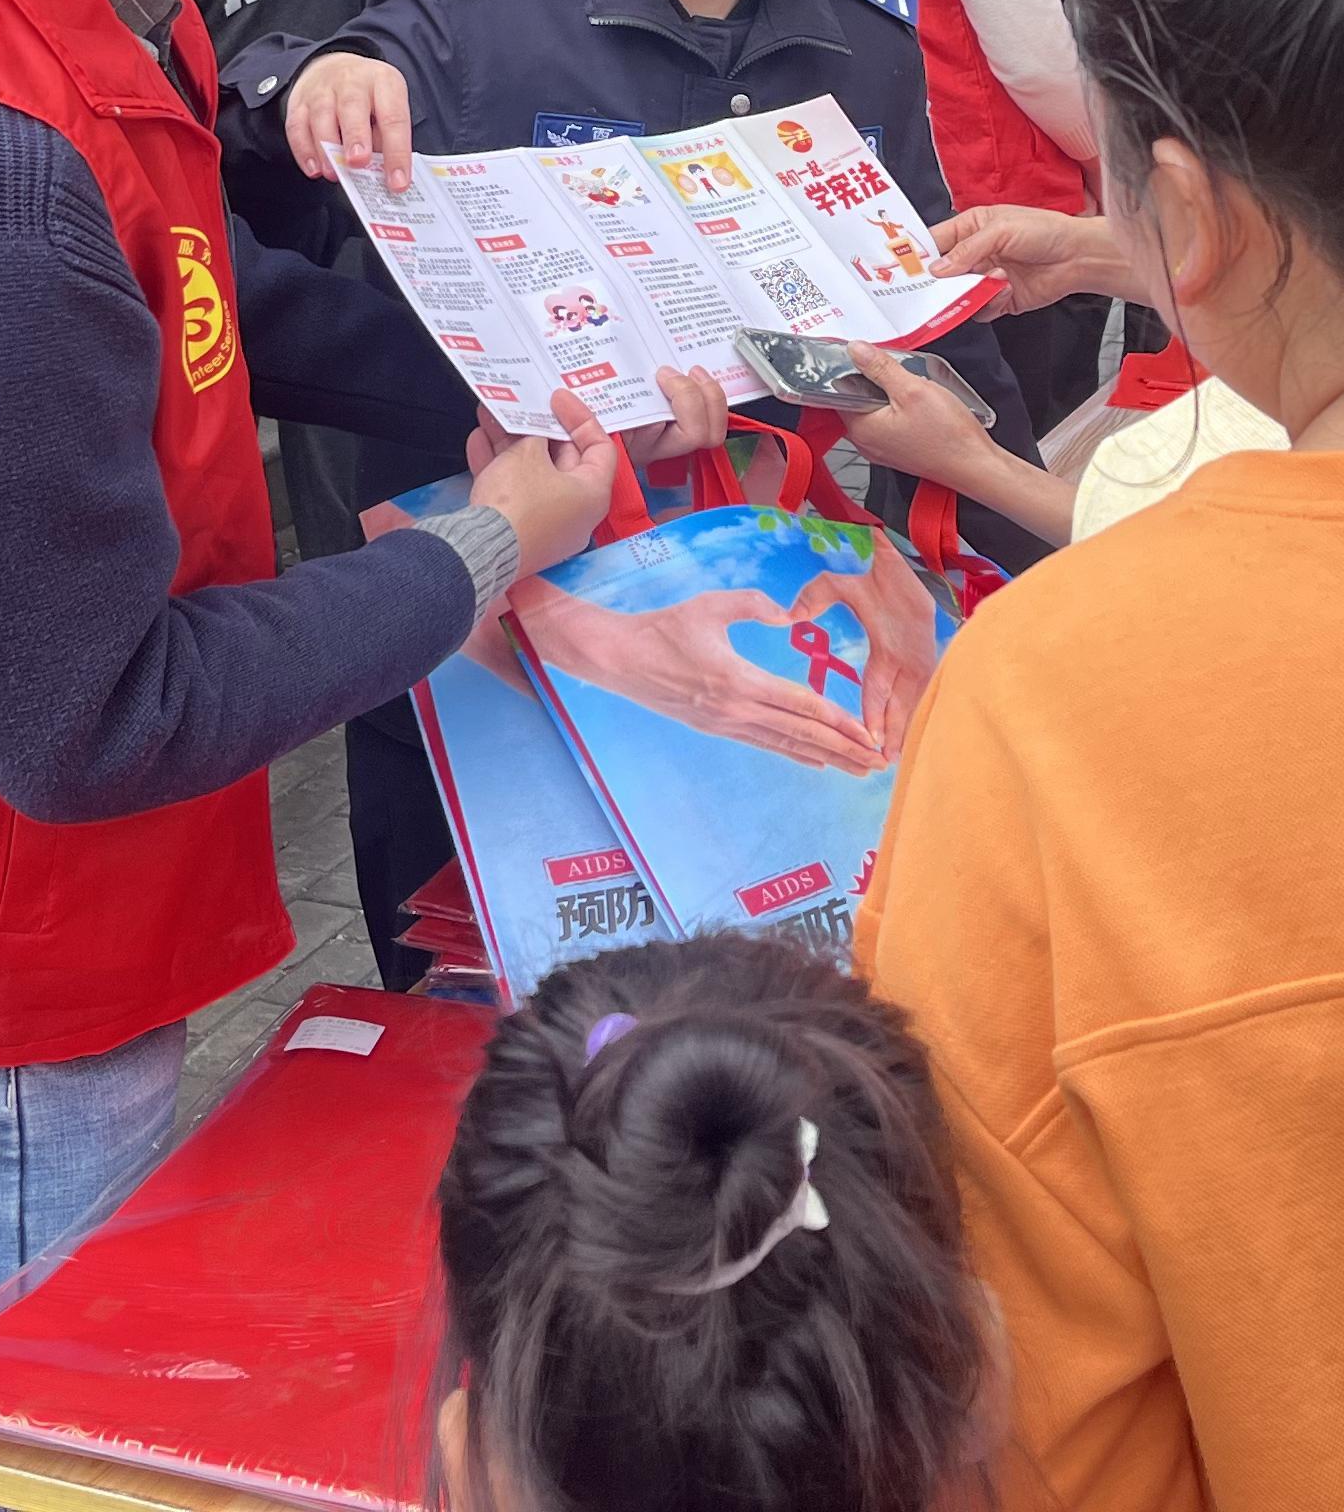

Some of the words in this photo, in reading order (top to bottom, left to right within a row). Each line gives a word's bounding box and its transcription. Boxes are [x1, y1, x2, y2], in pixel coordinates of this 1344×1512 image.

[775, 159, 825, 189] 我们一起
[803, 159, 891, 217] 学宪法
[220, 300, 233, 353] Service
[789, 306, 844, 335] 关注扫一扫
[568, 852, 627, 878] AIDS
[760, 870, 815, 906] AIDS
[556, 881, 654, 942] 预防
